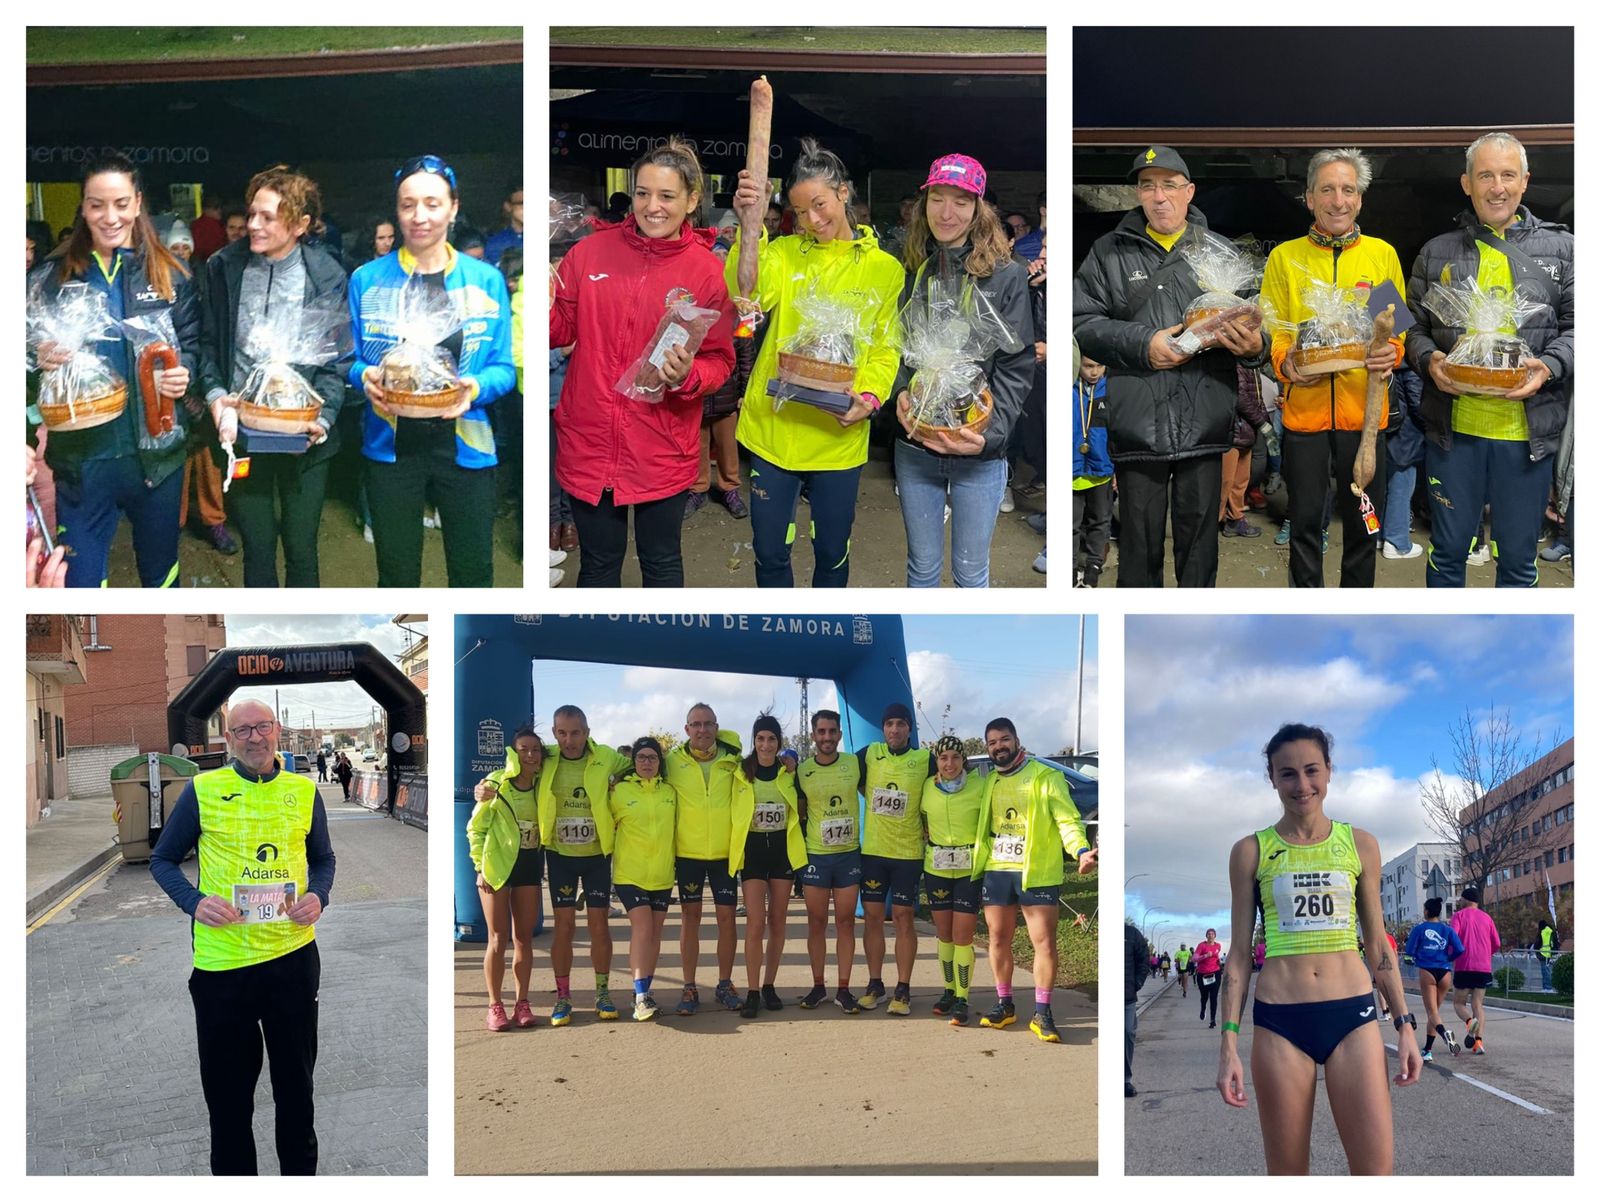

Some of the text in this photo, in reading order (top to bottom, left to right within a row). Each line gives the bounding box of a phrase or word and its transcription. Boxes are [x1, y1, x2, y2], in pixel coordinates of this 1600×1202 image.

[578, 131, 674, 152] alimento
[702, 139, 784, 160] zama
[723, 614, 750, 631] DE
[762, 616, 845, 637] ZAMORA
[237, 655, 269, 675] OCIO
[284, 650, 356, 673] AVENTURA
[877, 796, 901, 810] 149
[757, 811, 781, 823] 150
[562, 825, 590, 838] 110
[827, 825, 851, 839] 174
[998, 841, 1024, 856] 136
[948, 852, 956, 863] 1
[241, 866, 289, 879] Adarsa
[257, 903, 274, 920] 19
[1293, 893, 1335, 918] 260
